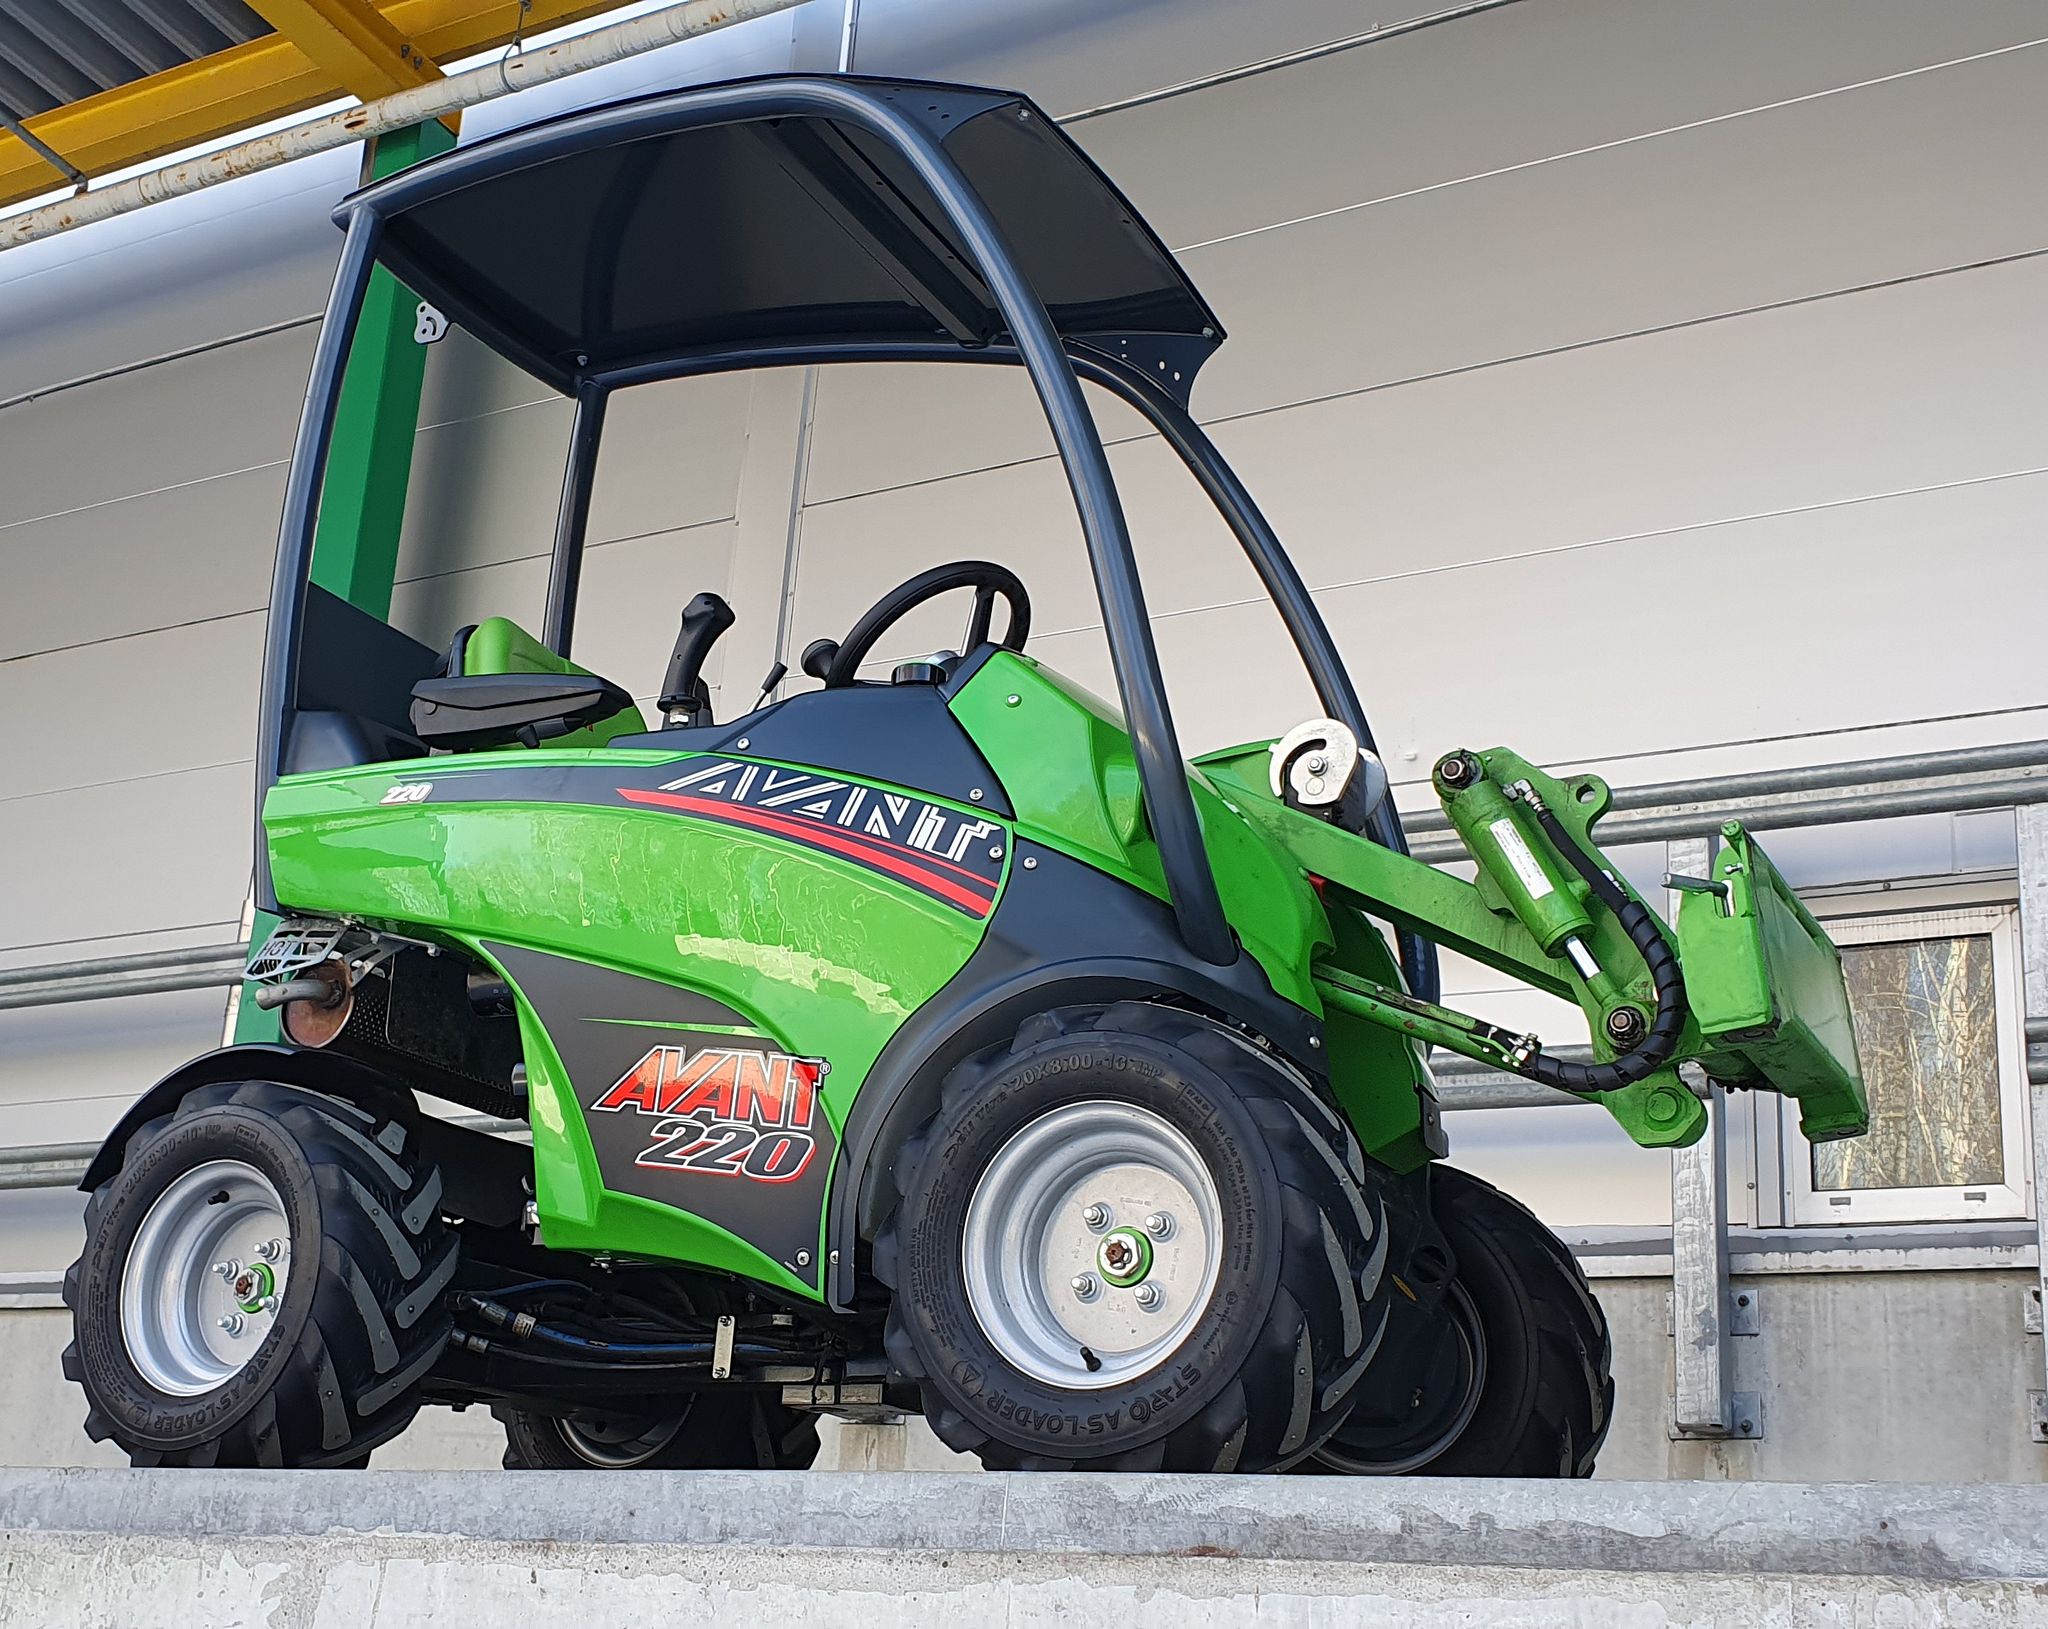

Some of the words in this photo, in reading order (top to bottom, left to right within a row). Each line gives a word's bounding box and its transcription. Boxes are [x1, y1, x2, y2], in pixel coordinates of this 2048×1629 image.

[379, 782, 433, 806] 220
[658, 762, 1001, 862] AVANT
[635, 1118, 816, 1183] 220
[986, 1391, 1079, 1436] LOADER
